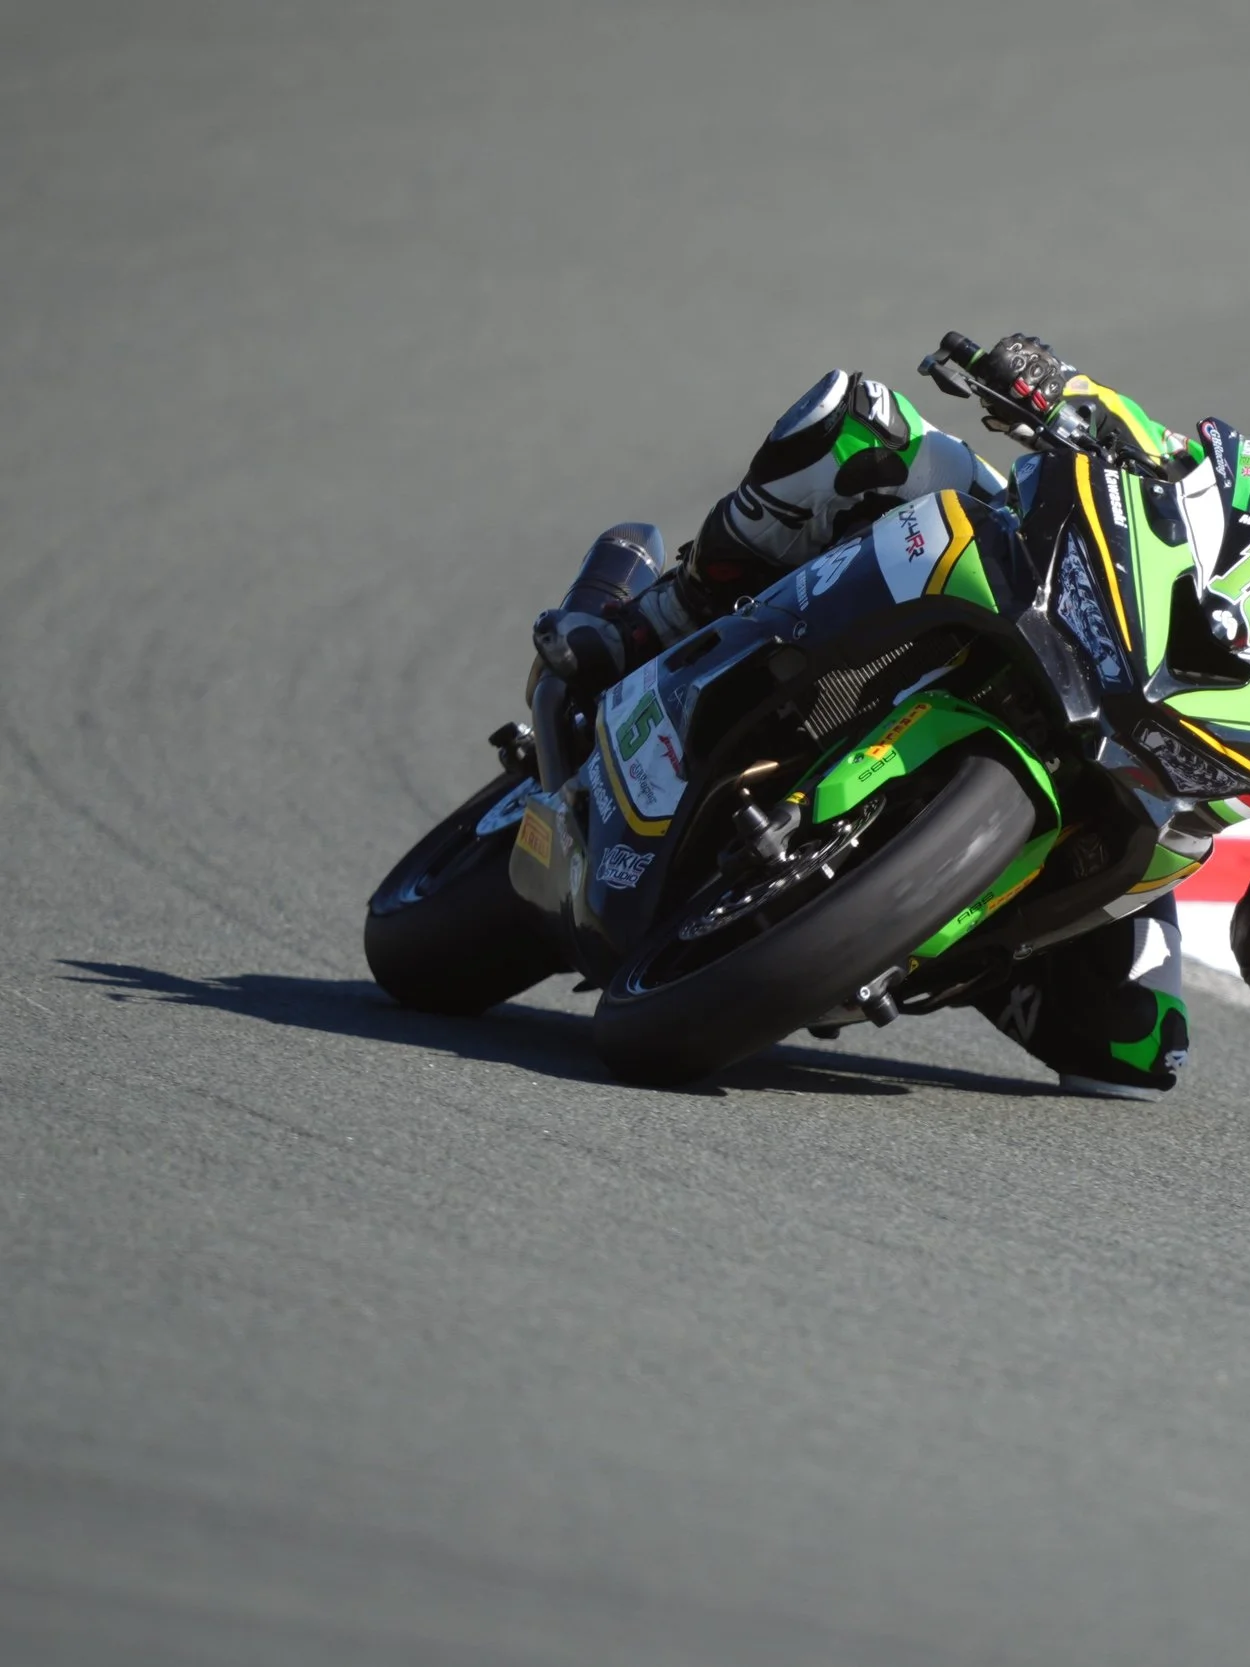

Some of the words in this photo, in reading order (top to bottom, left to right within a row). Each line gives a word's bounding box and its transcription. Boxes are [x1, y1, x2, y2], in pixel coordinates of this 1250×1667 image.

[1209, 428, 1228, 478] GBRacing
[1103, 468, 1128, 529] Kawasaki
[588, 751, 617, 825] Kawasaki
[858, 750, 897, 783] ABS
